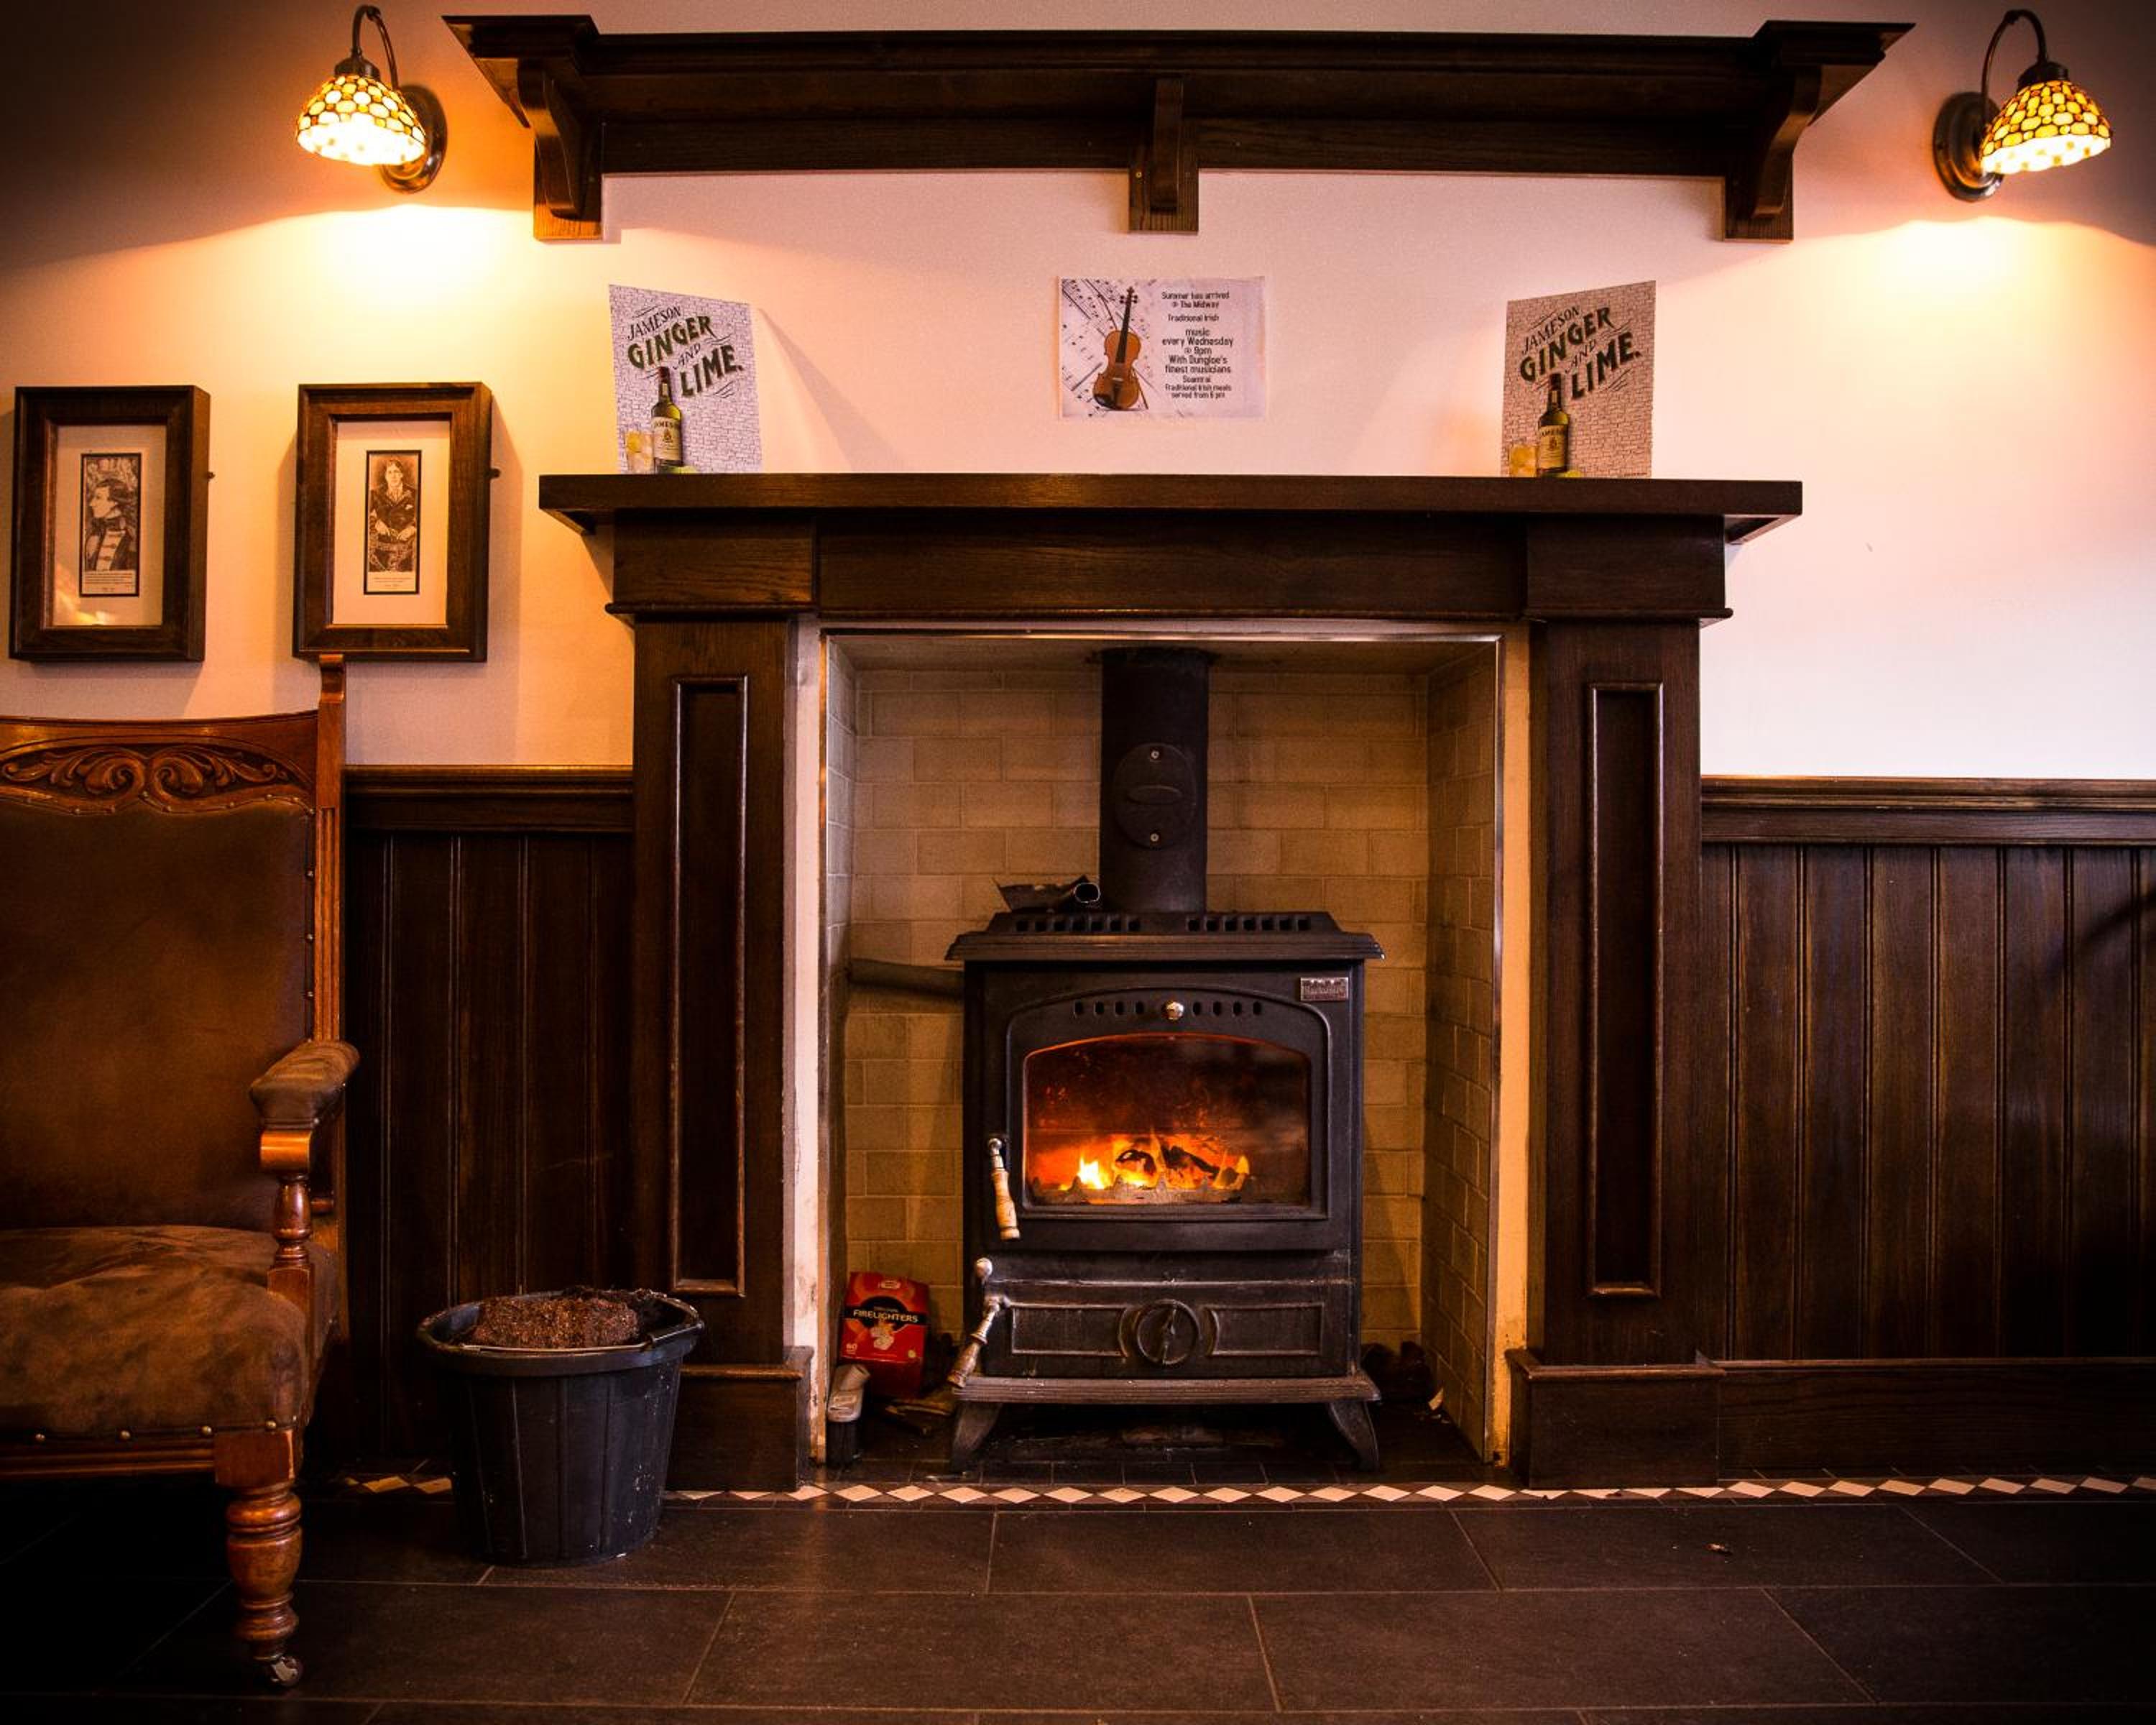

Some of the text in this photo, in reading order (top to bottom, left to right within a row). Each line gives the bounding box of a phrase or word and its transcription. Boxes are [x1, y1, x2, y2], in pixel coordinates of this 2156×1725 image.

[1193, 300, 1220, 309] Midway
[627, 306, 681, 341] JAMESON
[1522, 306, 1580, 355] JAMESON
[627, 316, 717, 369] GINGER
[673, 343, 701, 369] AND
[1162, 336, 1233, 347] every Wednesday
[1520, 307, 1616, 382] GINGER
[1565, 339, 1597, 373] AND
[1169, 355, 1227, 365] With Dungloe's
[853, 1309, 918, 1323] FIRELIGHTERS
